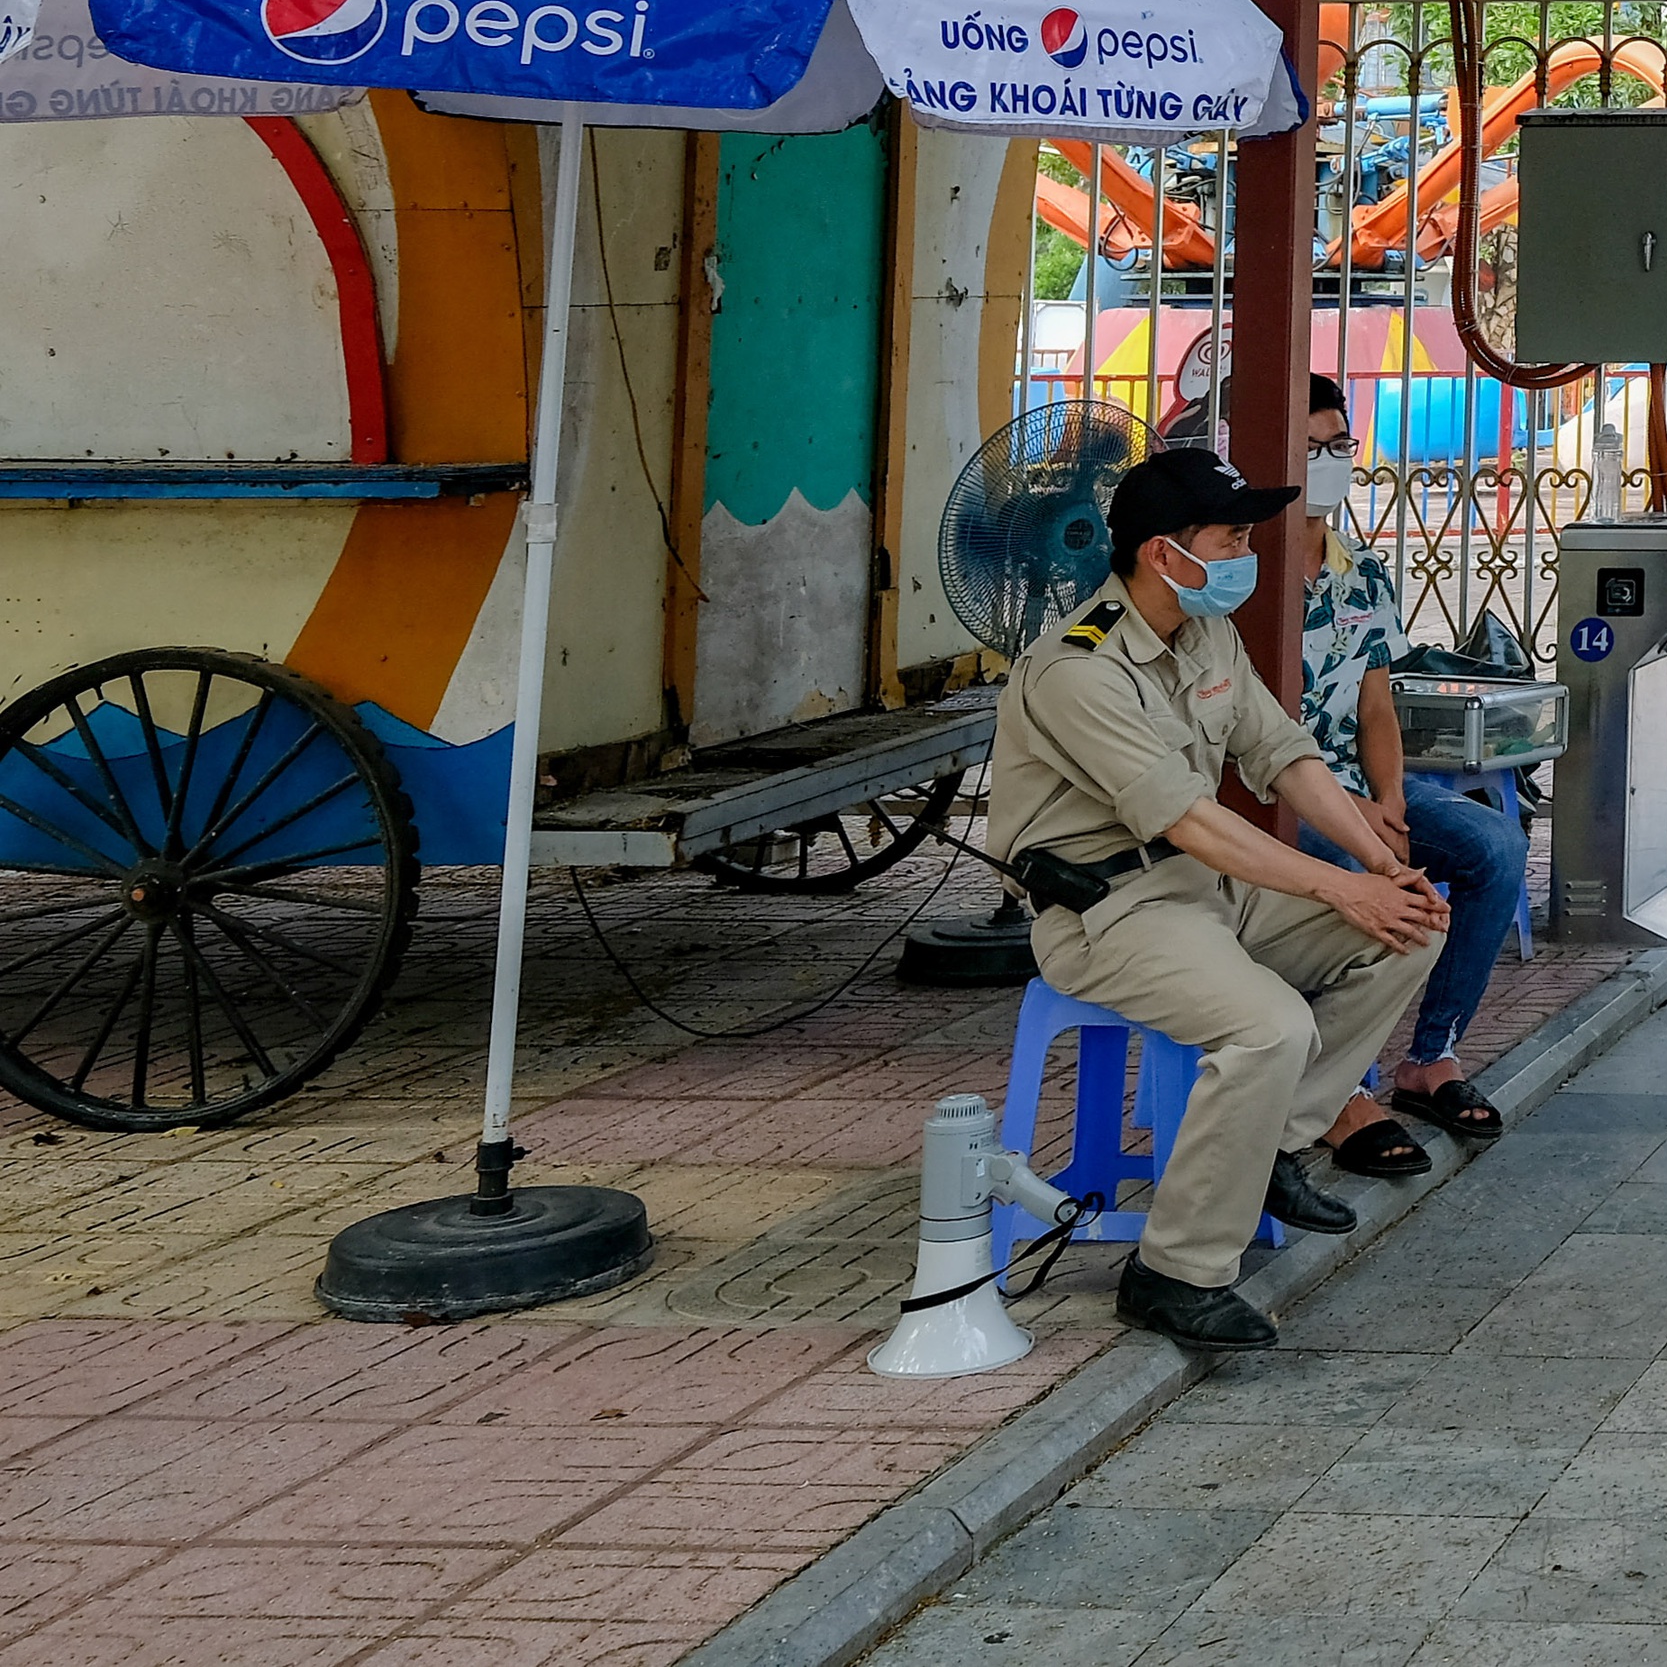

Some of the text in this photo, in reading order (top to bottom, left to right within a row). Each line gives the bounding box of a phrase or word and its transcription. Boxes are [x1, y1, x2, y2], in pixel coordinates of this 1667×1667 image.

[940, 10, 1199, 69] UỐNG pepsi
[890, 68, 978, 113] ẢNG
[989, 77, 1087, 118] KHOÁI
[1096, 80, 1184, 121] TỪNG
[1577, 626, 1609, 652] 14
